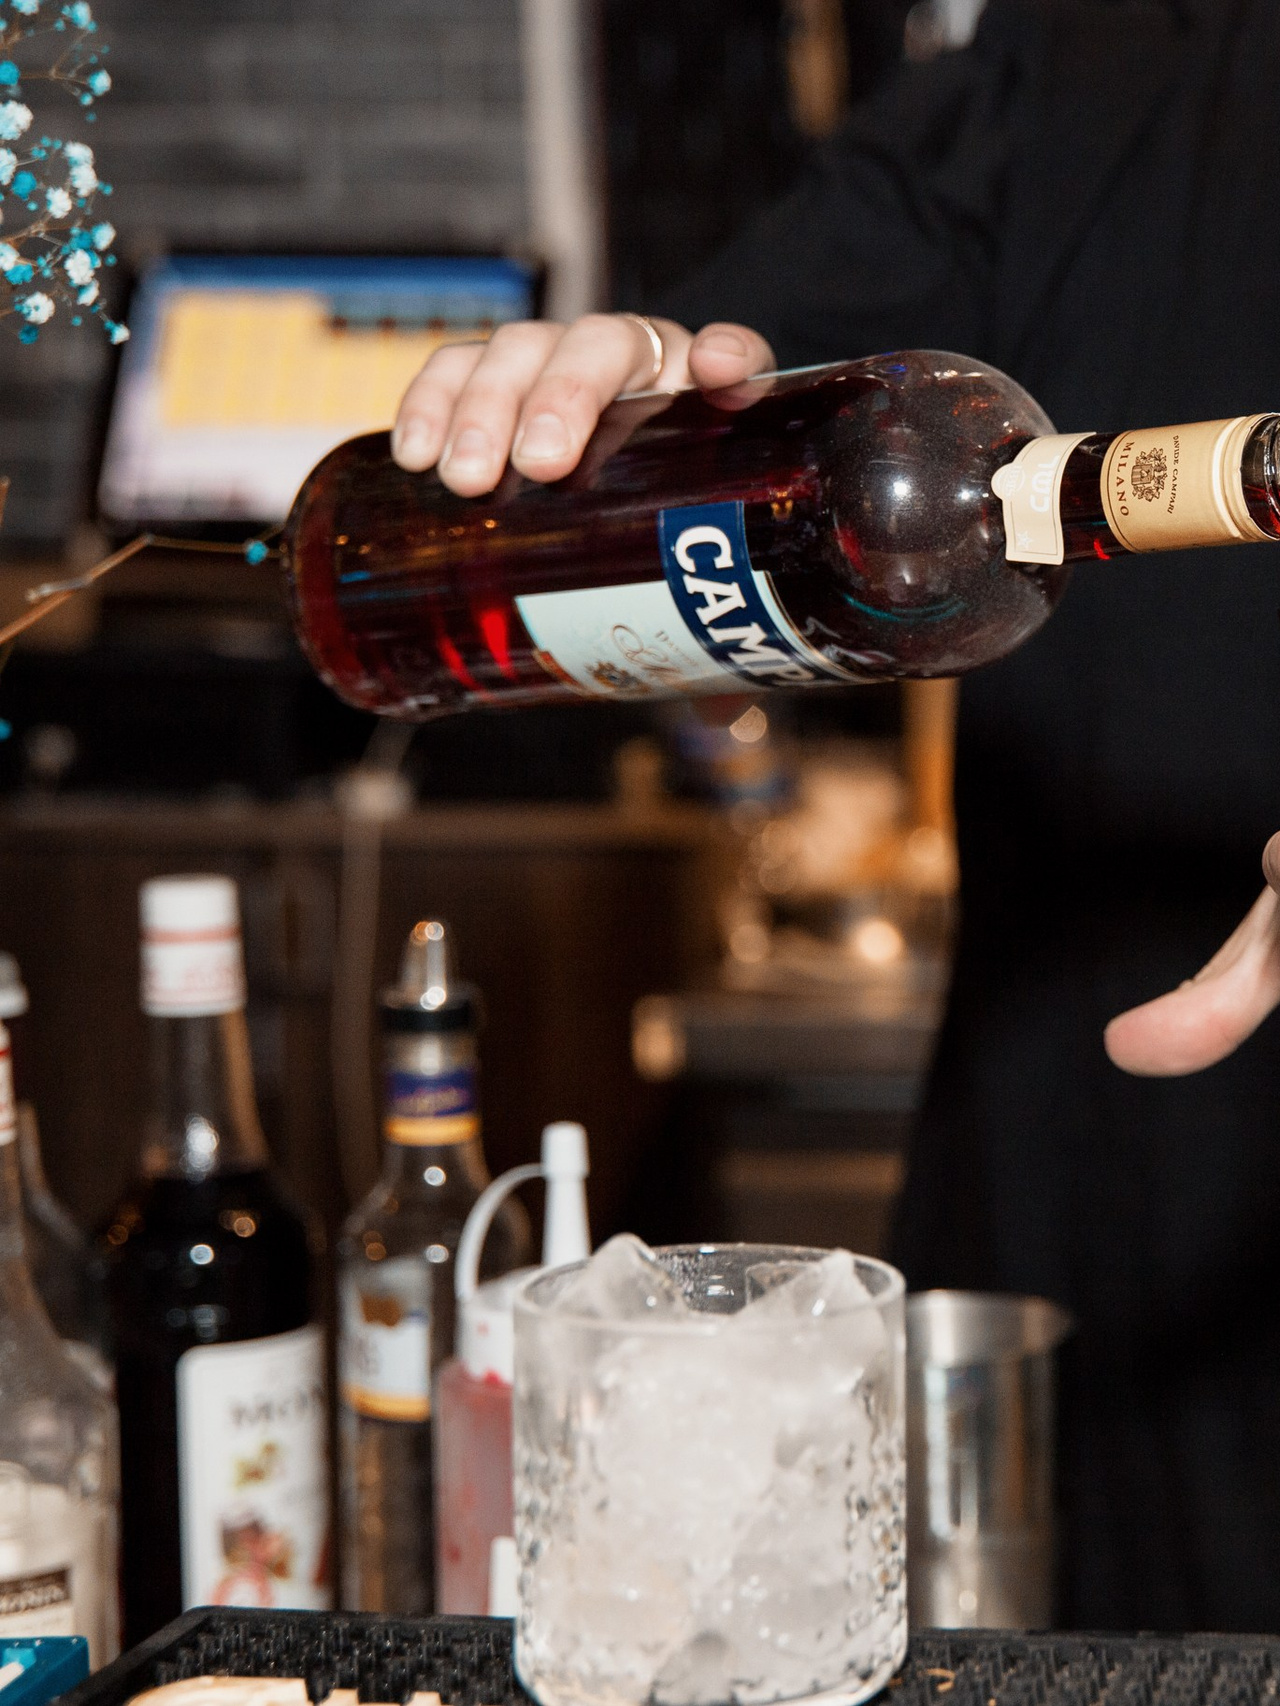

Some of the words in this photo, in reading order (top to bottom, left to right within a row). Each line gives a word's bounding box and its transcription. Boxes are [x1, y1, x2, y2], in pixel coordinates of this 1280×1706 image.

[1116, 441, 1135, 517] MILANO
[1172, 435, 1180, 465] DAVIDE
[1166, 468, 1180, 515] CAMPARI
[674, 525, 816, 686] CAMP
